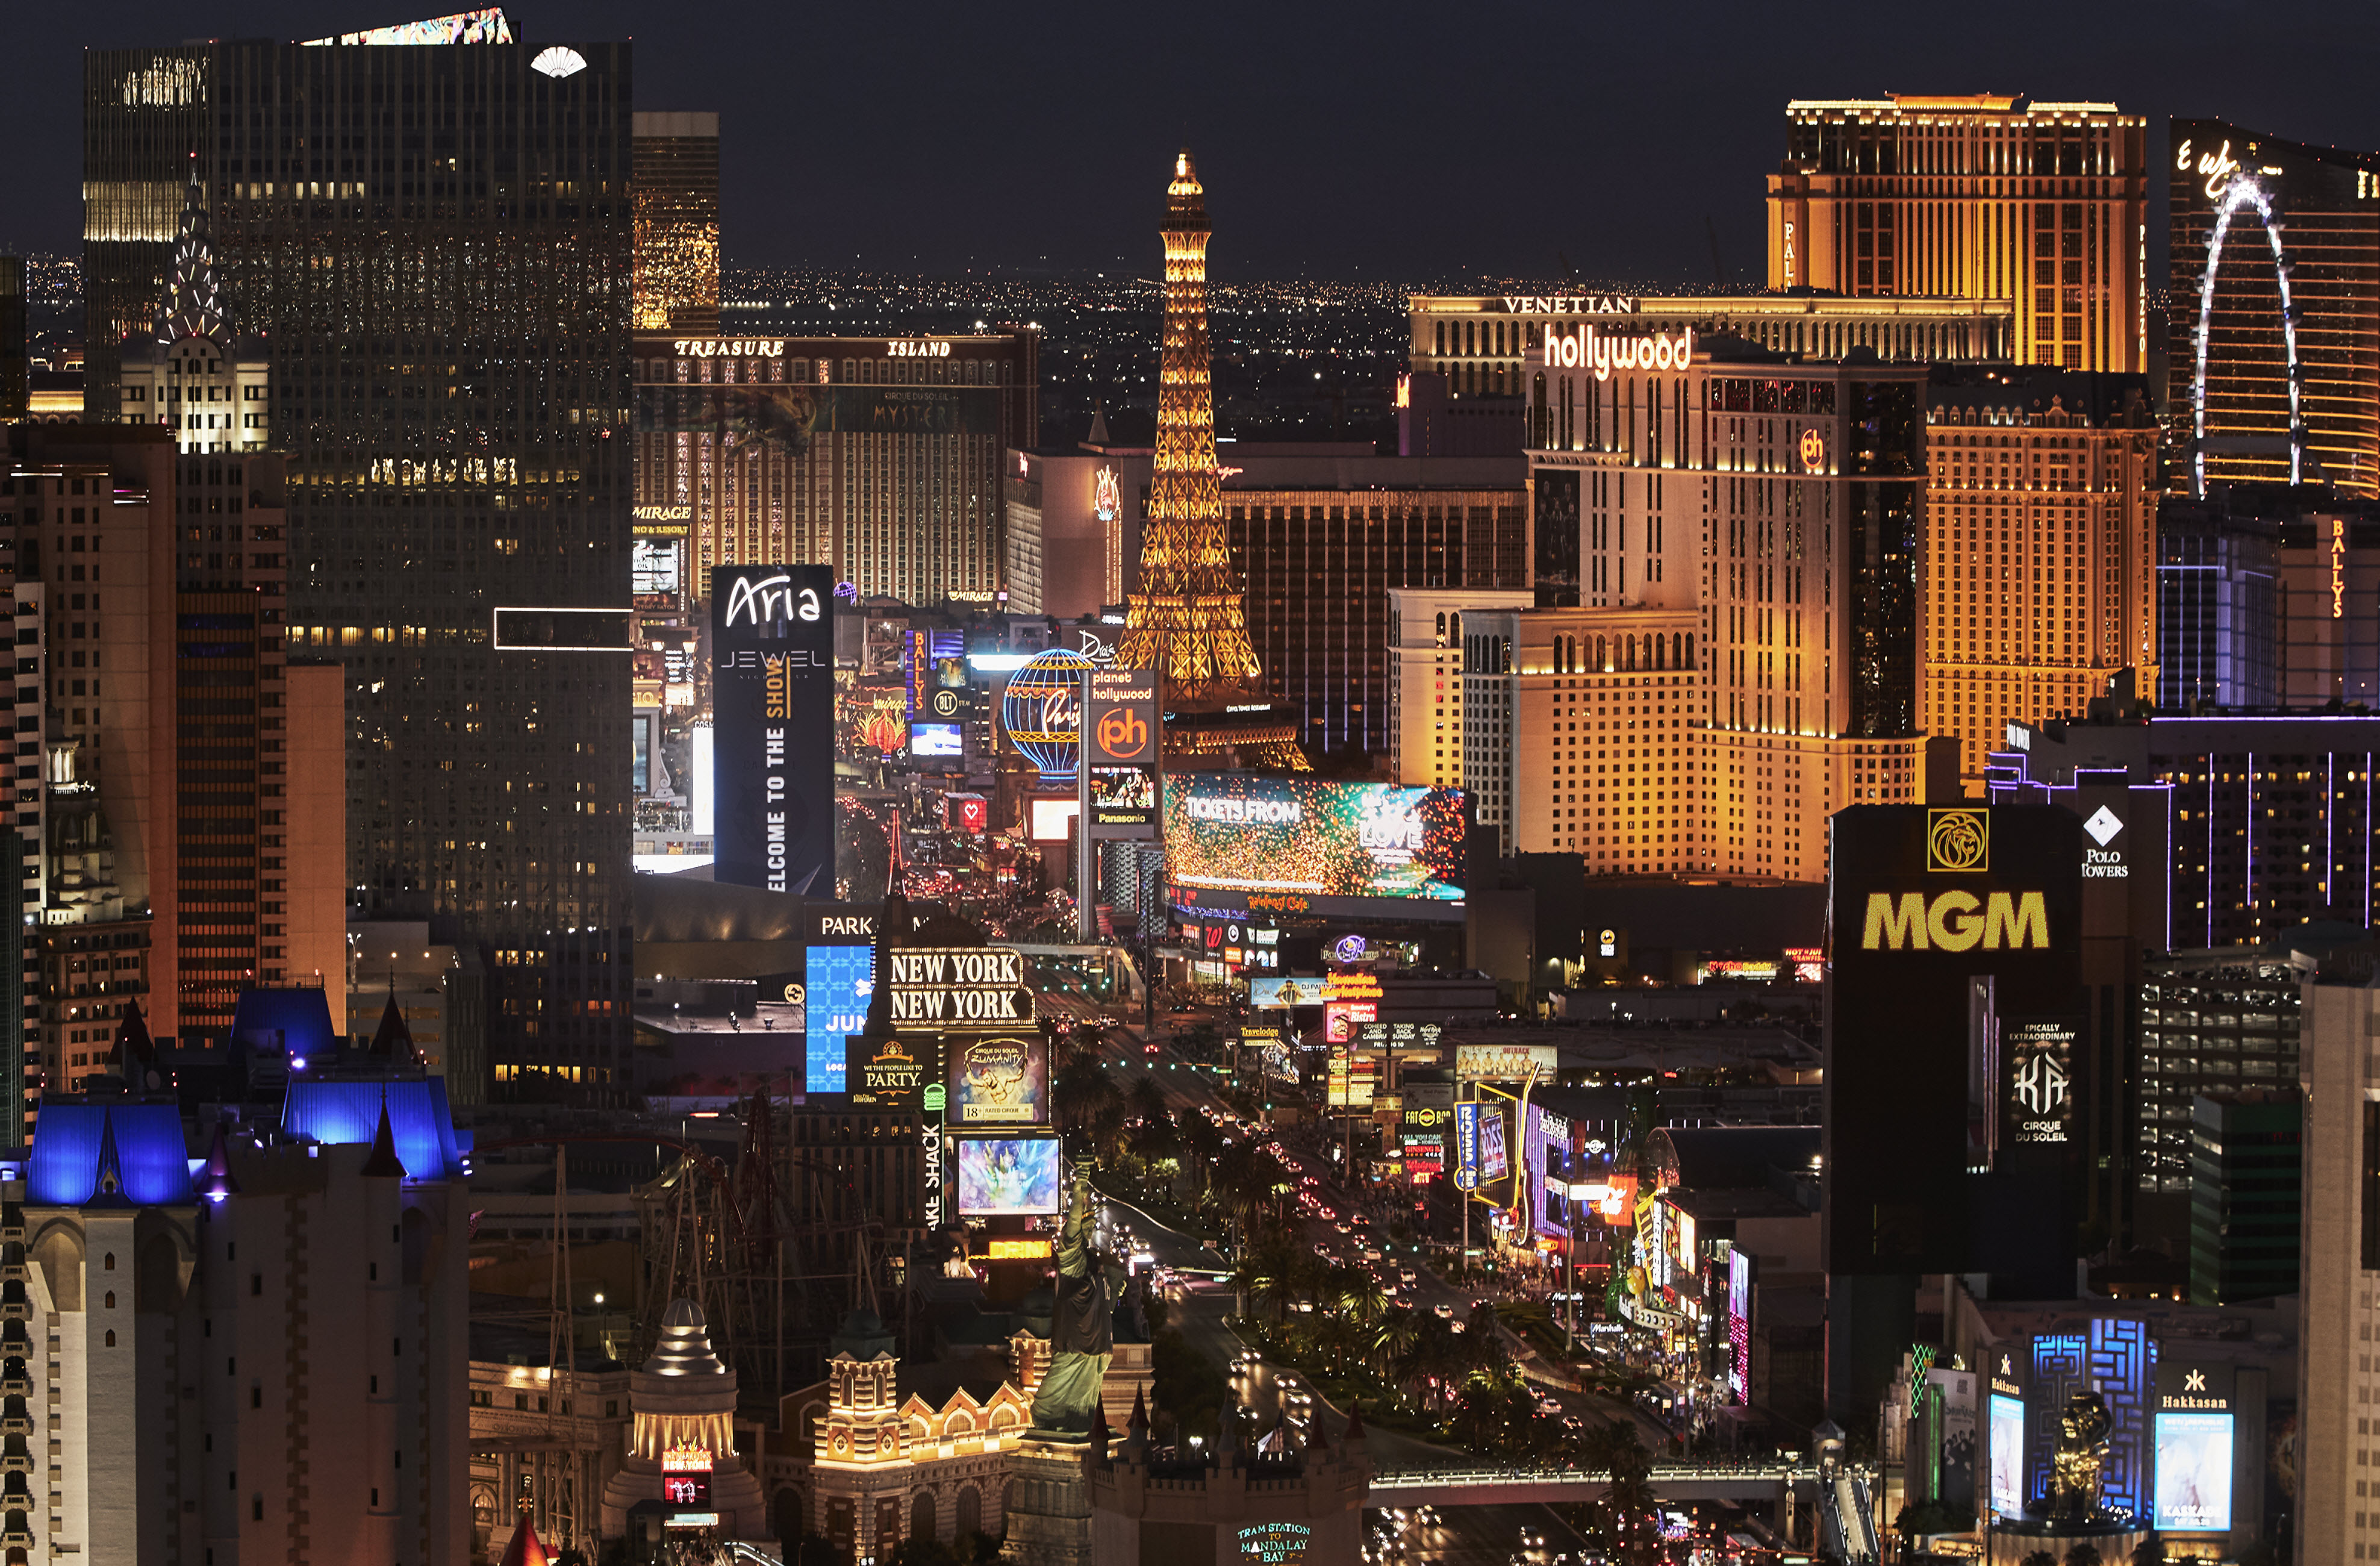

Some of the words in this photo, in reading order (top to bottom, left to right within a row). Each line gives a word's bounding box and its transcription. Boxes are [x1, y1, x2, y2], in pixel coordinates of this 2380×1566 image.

[1504, 297, 1633, 314] VENETIAN
[674, 340, 784, 358] TREASURE
[888, 341, 950, 357] ISLAND
[1544, 323, 1692, 381] hollywood
[632, 506, 691, 521] MIRAGE
[656, 525, 688, 535] RESORT
[2331, 520, 2346, 618] BALLYS
[726, 575, 820, 628] Aria
[956, 591, 994, 602] MIRAGE
[1079, 629, 1115, 661] Drai's
[721, 650, 826, 668] JEWEL
[914, 632, 925, 711] BALLYS
[1092, 670, 1132, 685] planet
[766, 657, 783, 719] SHOW
[1092, 687, 1152, 703] hollywood
[939, 696, 953, 710] BLT
[766, 728, 784, 768] THE
[767, 776, 785, 803] TO
[1186, 796, 1244, 820] TICKETS
[1246, 802, 1300, 823] FROM
[1098, 813, 1145, 823] Panasonic
[2087, 849, 2120, 864] POLO
[2081, 864, 2128, 878] TOWERS
[1248, 894, 1286, 911] Rainforest
[822, 917, 873, 935] PARK
[1861, 890, 2050, 952] MGM
[891, 954, 945, 983] NEW
[952, 954, 1017, 983] YORK
[891, 991, 945, 1019] NEW
[952, 991, 1017, 1019] YORK
[1350, 1011, 1375, 1022] Bistro
[1241, 1026, 1279, 1037] Travelodge
[2025, 1024, 2060, 1032] EPICALLY
[2009, 1032, 2075, 1041] EXTRAORDINARY
[971, 1052, 1024, 1068] ZUMANITY
[865, 1072, 921, 1087] PARTY.
[1406, 1111, 1419, 1125] FAT
[2023, 1121, 2061, 1133] CIRQUE
[2016, 1133, 2031, 1142] DU
[2033, 1132, 2067, 1142] SOLEIL
[922, 1123, 939, 1189] SHACK
[1592, 1324, 1624, 1332] Marshalls
[1992, 1377, 2020, 1395] Hakkasan
[2163, 1396, 2227, 1409] Hakkasan
[662, 1461, 684, 1470] NEW
[685, 1461, 712, 1470] YORK
[1238, 1524, 1266, 1540] TRAM
[1267, 1521, 1311, 1535] STATION
[1240, 1539, 1308, 1553] MANDALAY
[1263, 1550, 1285, 1562] BAY
